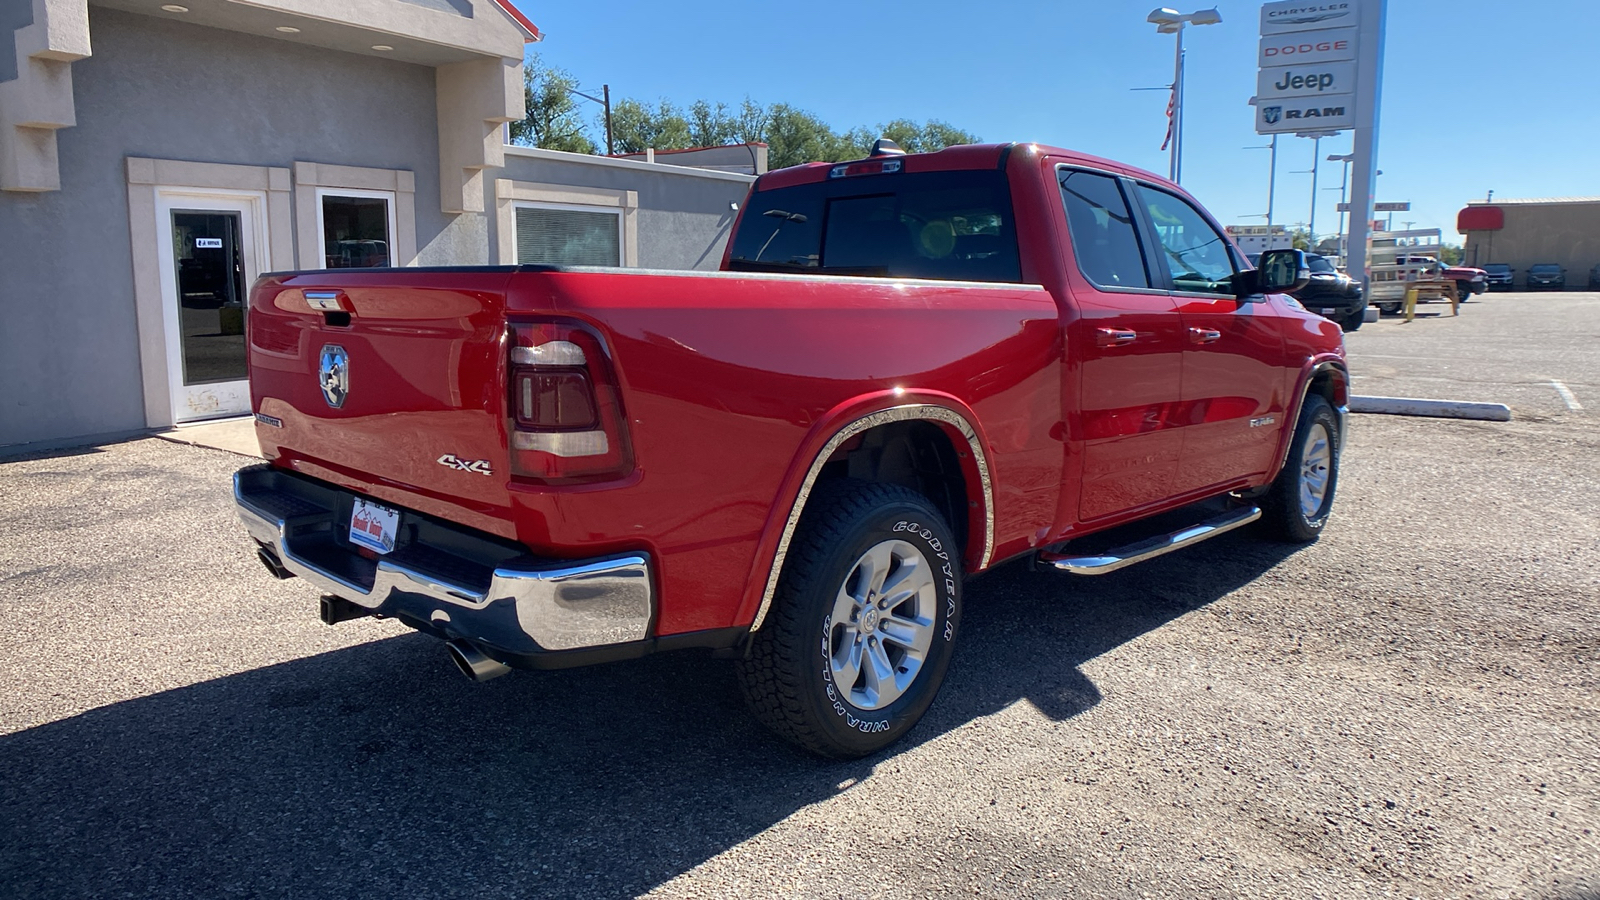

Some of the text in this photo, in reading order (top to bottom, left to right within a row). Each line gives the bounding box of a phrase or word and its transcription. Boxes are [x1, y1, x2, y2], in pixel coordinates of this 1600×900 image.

[1268, 3, 1349, 18] CHRYSLER
[1264, 40, 1348, 57] DODGE
[1275, 71, 1334, 92] Jeep
[1285, 106, 1345, 119] RAM
[892, 521, 956, 642] GOODYEAR
[821, 614, 891, 733] WRANGLER
